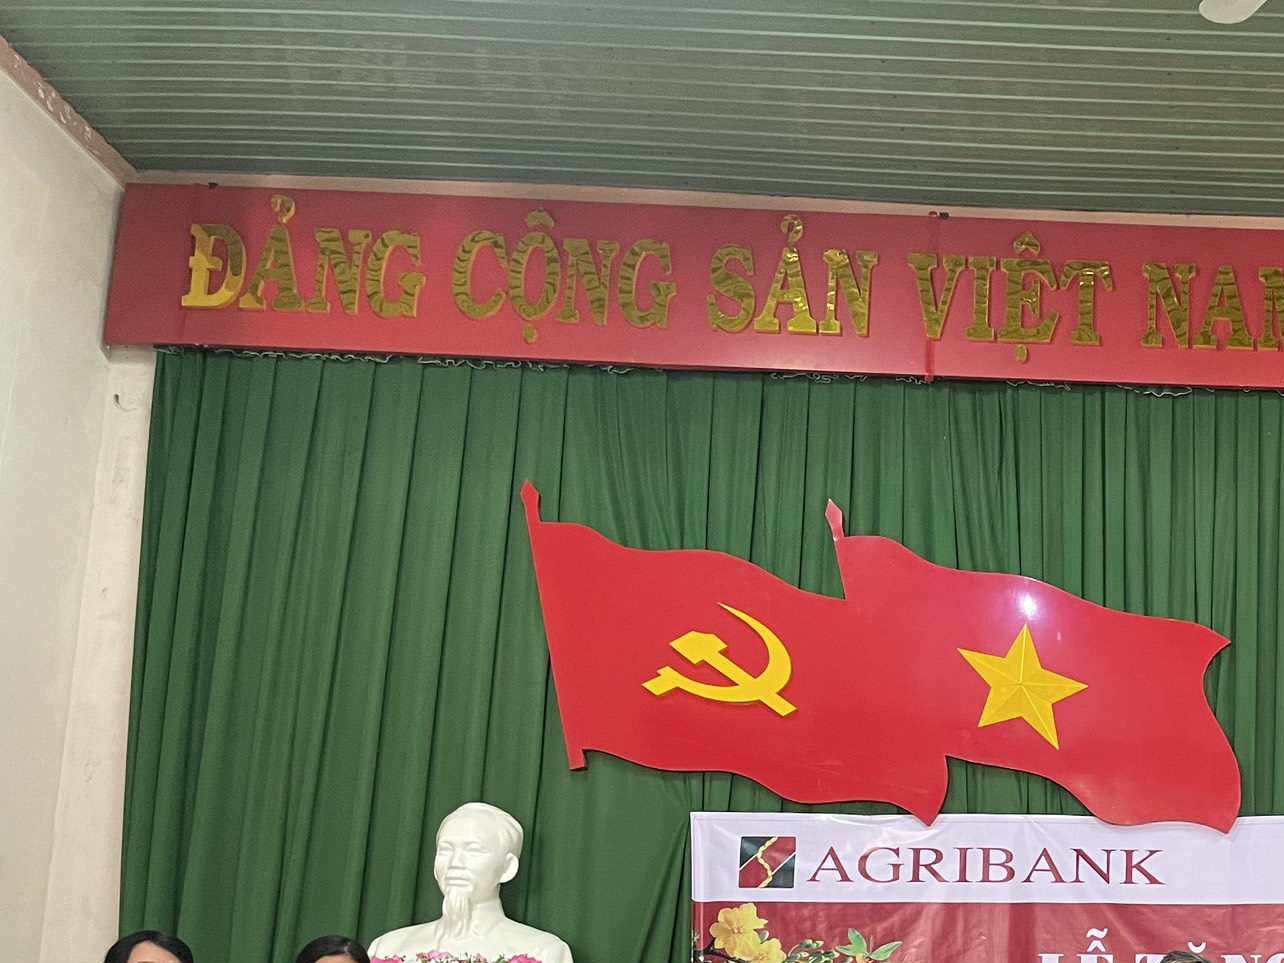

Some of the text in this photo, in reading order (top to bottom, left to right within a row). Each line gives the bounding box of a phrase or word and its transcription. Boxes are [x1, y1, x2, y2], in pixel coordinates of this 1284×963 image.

[181, 194, 427, 319] ĐẢNG
[451, 206, 678, 343] CỘNG
[706, 213, 882, 338] SẢN
[907, 231, 1114, 364] VIỆT
[806, 846, 1165, 885] AGRIBANK
